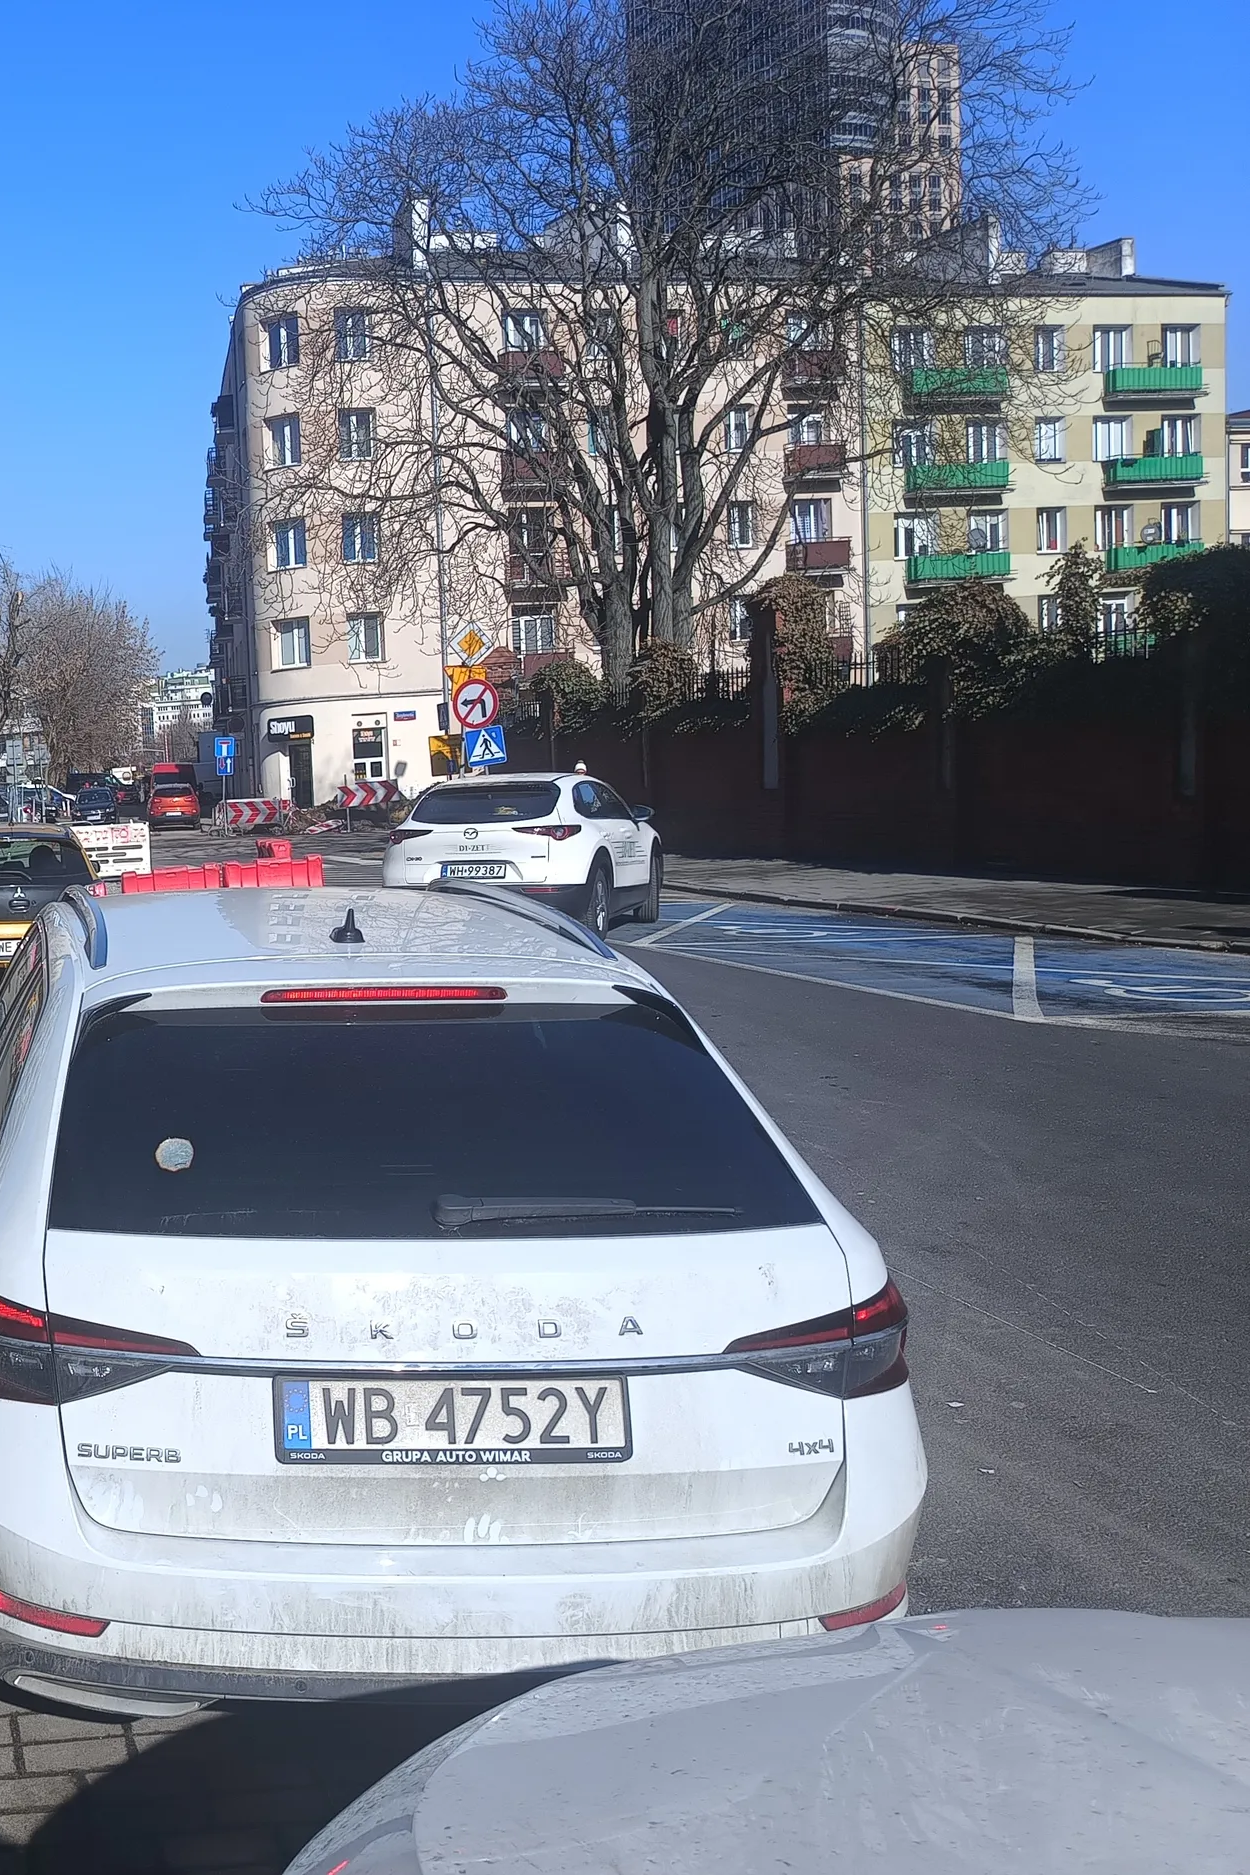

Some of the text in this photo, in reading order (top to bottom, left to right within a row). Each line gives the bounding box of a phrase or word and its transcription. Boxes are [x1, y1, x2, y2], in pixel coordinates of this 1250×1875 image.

[270, 721, 296, 735] Shoyu
[449, 866, 503, 876] WH 99387
[287, 1387, 608, 1445] PL WB 4752Y
[77, 1442, 182, 1463] SUPERB
[381, 1451, 432, 1462] GRUPA
[436, 1451, 477, 1462] AUTO
[479, 1451, 532, 1462] WIMAR
